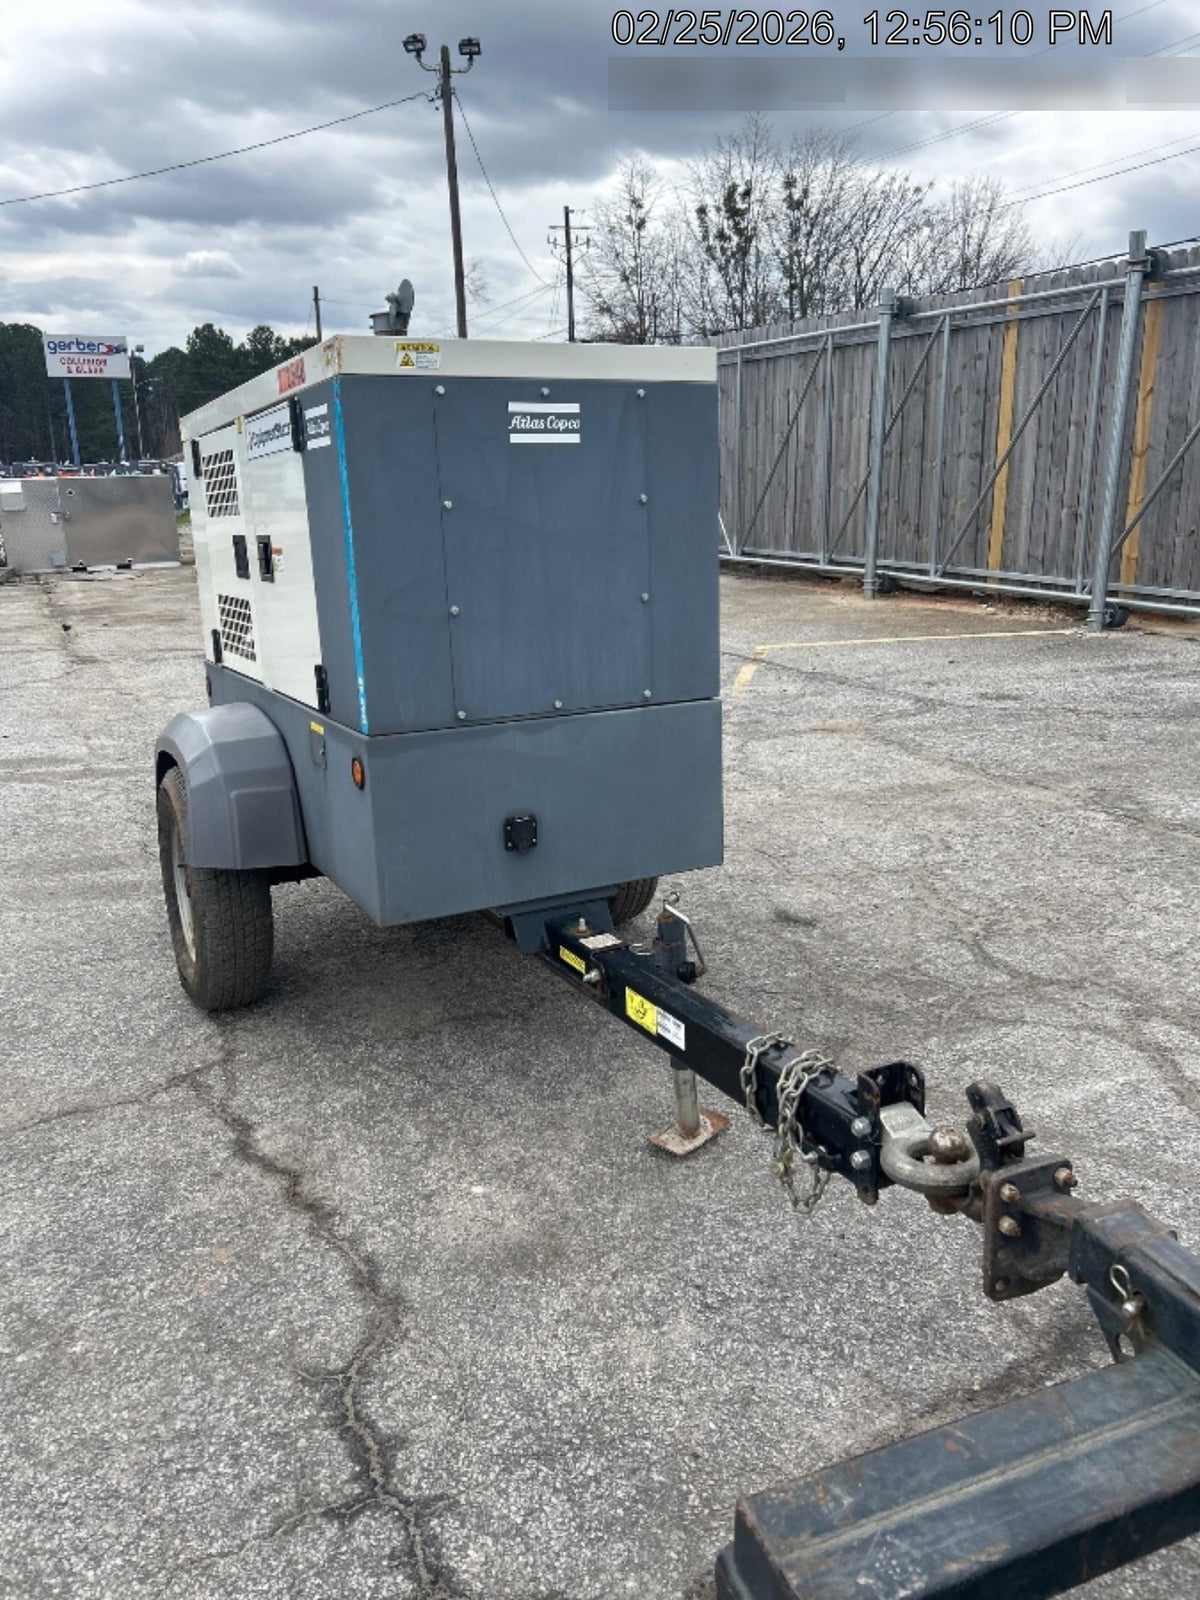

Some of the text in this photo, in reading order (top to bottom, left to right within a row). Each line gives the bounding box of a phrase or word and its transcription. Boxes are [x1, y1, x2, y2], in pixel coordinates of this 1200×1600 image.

[47, 338, 105, 354] gerber
[508, 415, 580, 432] Atlas Copco
